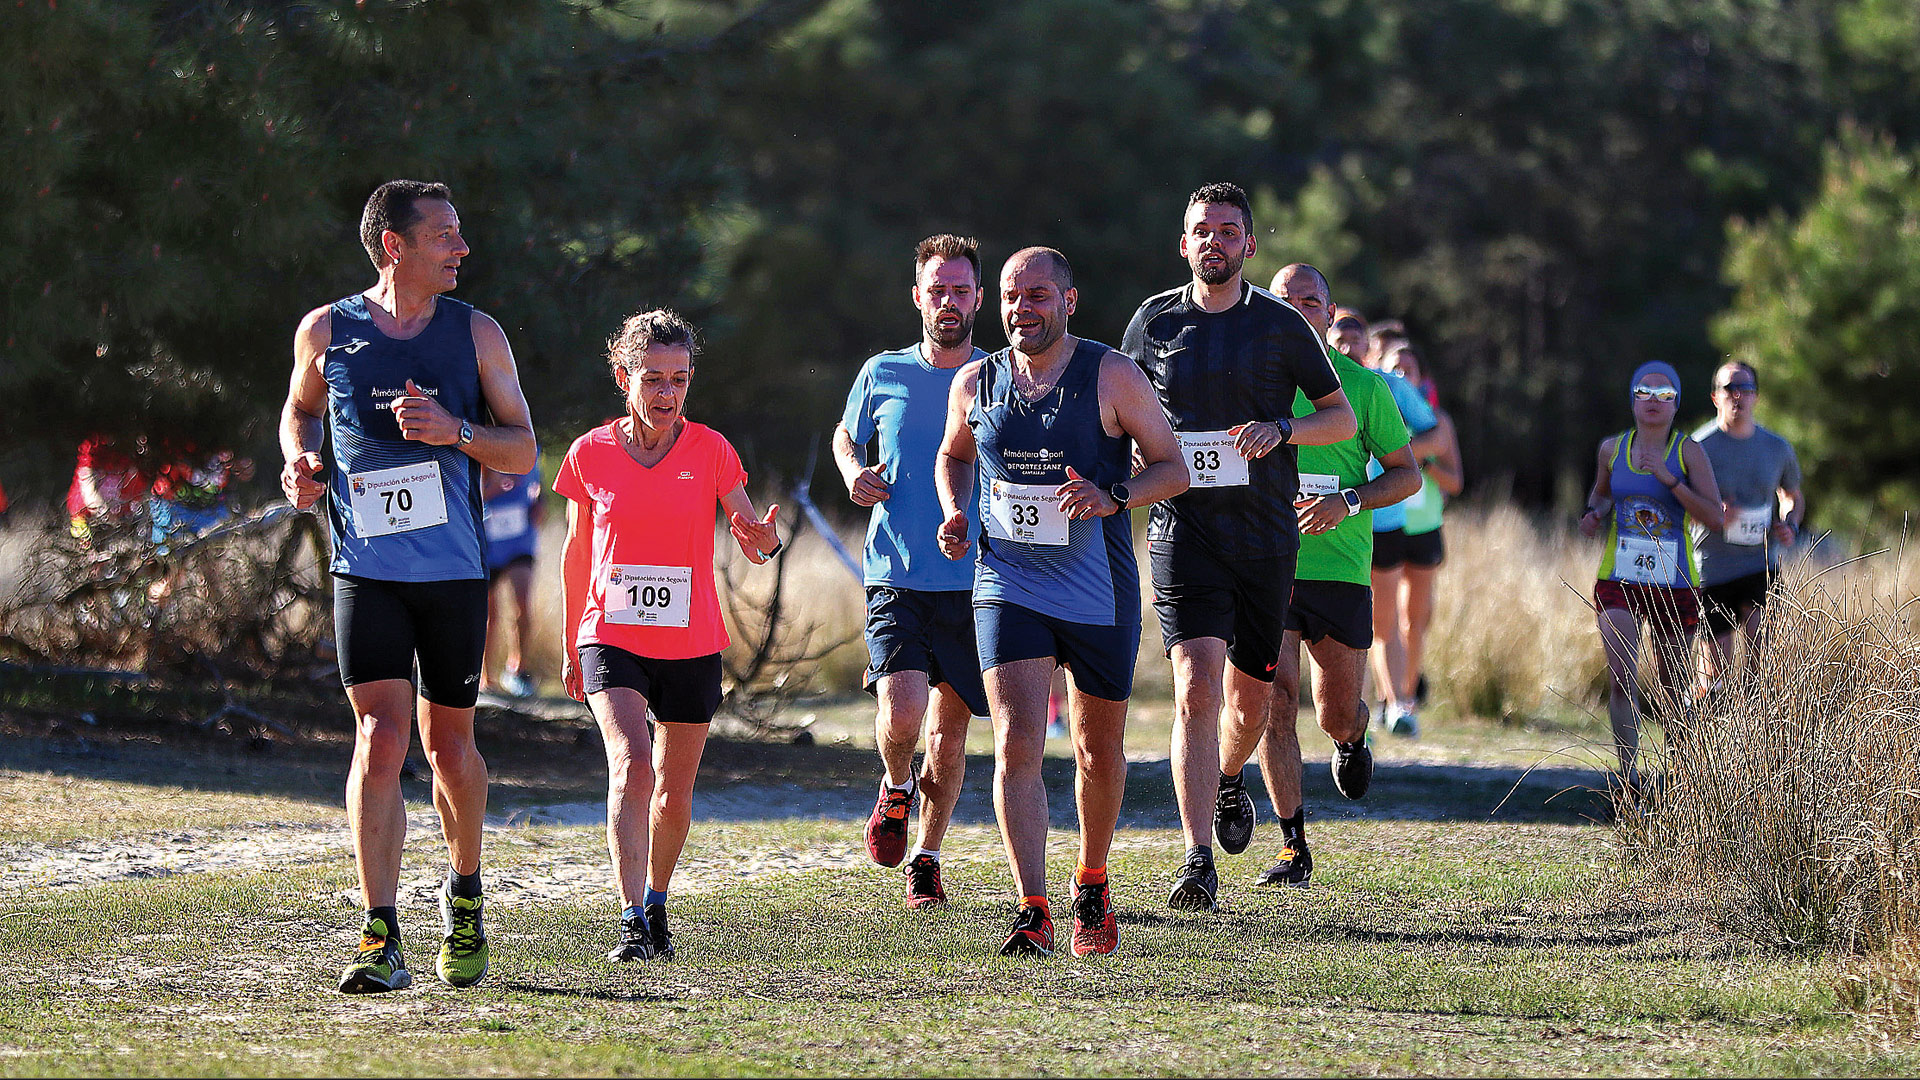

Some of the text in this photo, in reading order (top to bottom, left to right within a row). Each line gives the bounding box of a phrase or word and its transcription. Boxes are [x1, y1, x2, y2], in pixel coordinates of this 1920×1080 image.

[1184, 440, 1211, 448] Diputación
[1042, 463, 1062, 471] SANZ
[1193, 450, 1221, 471] 83
[367, 479, 400, 489] Diputación
[411, 473, 437, 482] Segovia
[380, 488, 413, 514] 70
[1003, 492, 1031, 501] Diputación
[1012, 503, 1040, 526] 33
[1634, 554, 1656, 571] 46
[624, 574, 656, 582] Diputación
[666, 576, 688, 584] Segovia
[628, 585, 672, 608] 109
